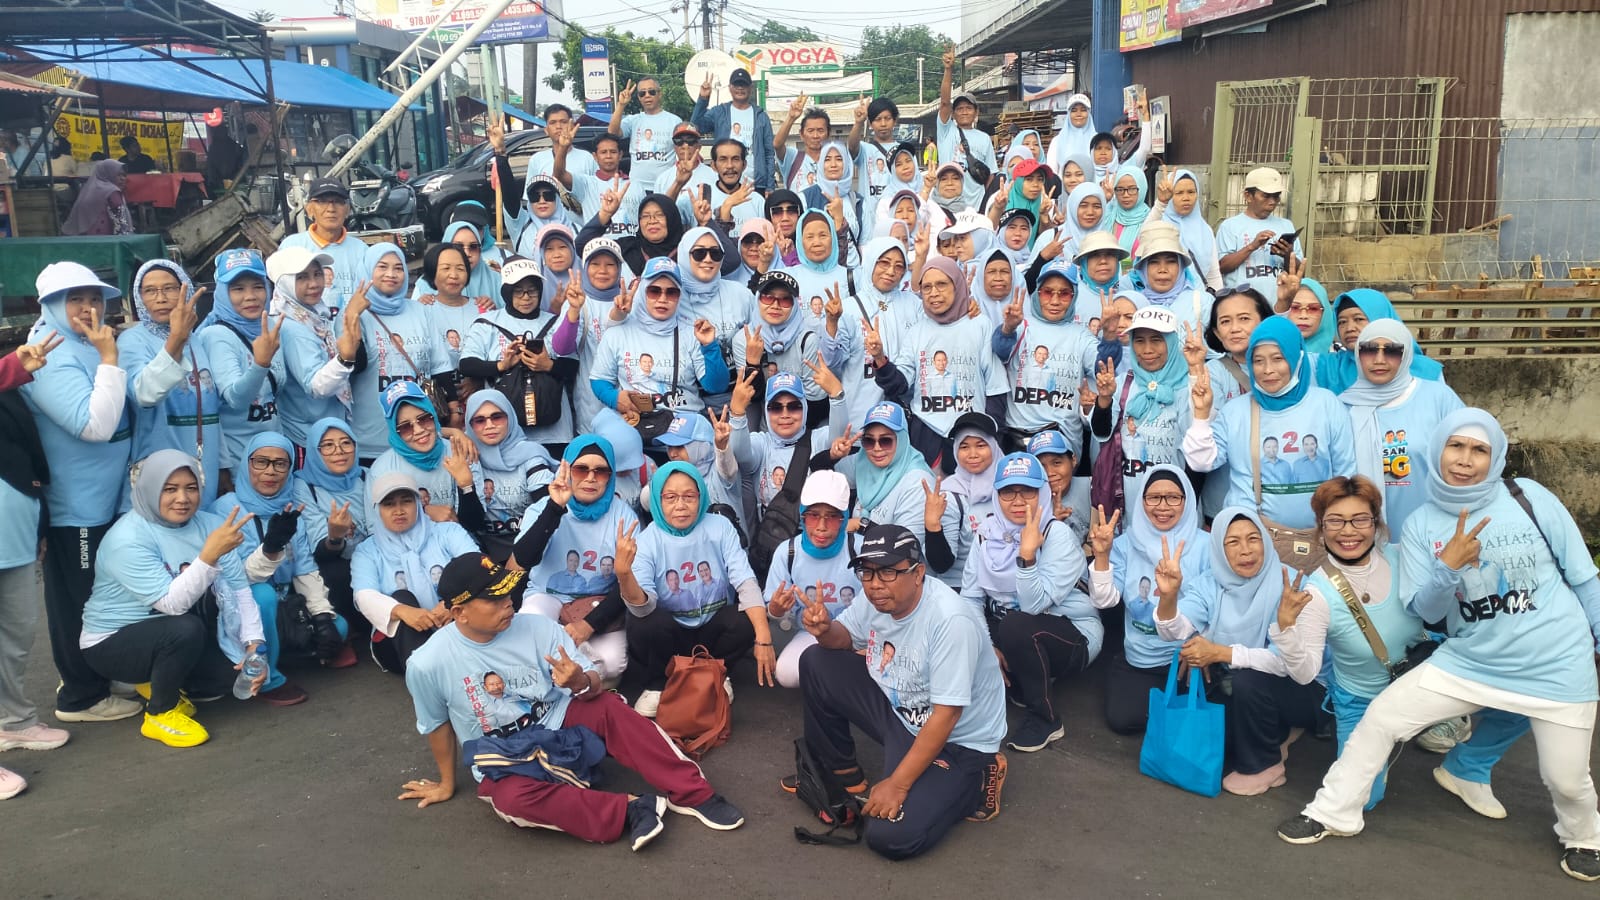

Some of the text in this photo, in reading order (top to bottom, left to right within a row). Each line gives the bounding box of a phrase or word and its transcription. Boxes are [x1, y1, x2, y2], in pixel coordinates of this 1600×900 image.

[768, 47, 838, 65] YOGYA
[758, 271, 798, 289] SPORT
[1282, 431, 1300, 453] 2
[79, 539, 89, 569] ARMOUR
[583, 550, 597, 571] 2
[680, 562, 697, 583] 2
[823, 582, 838, 603] 2
